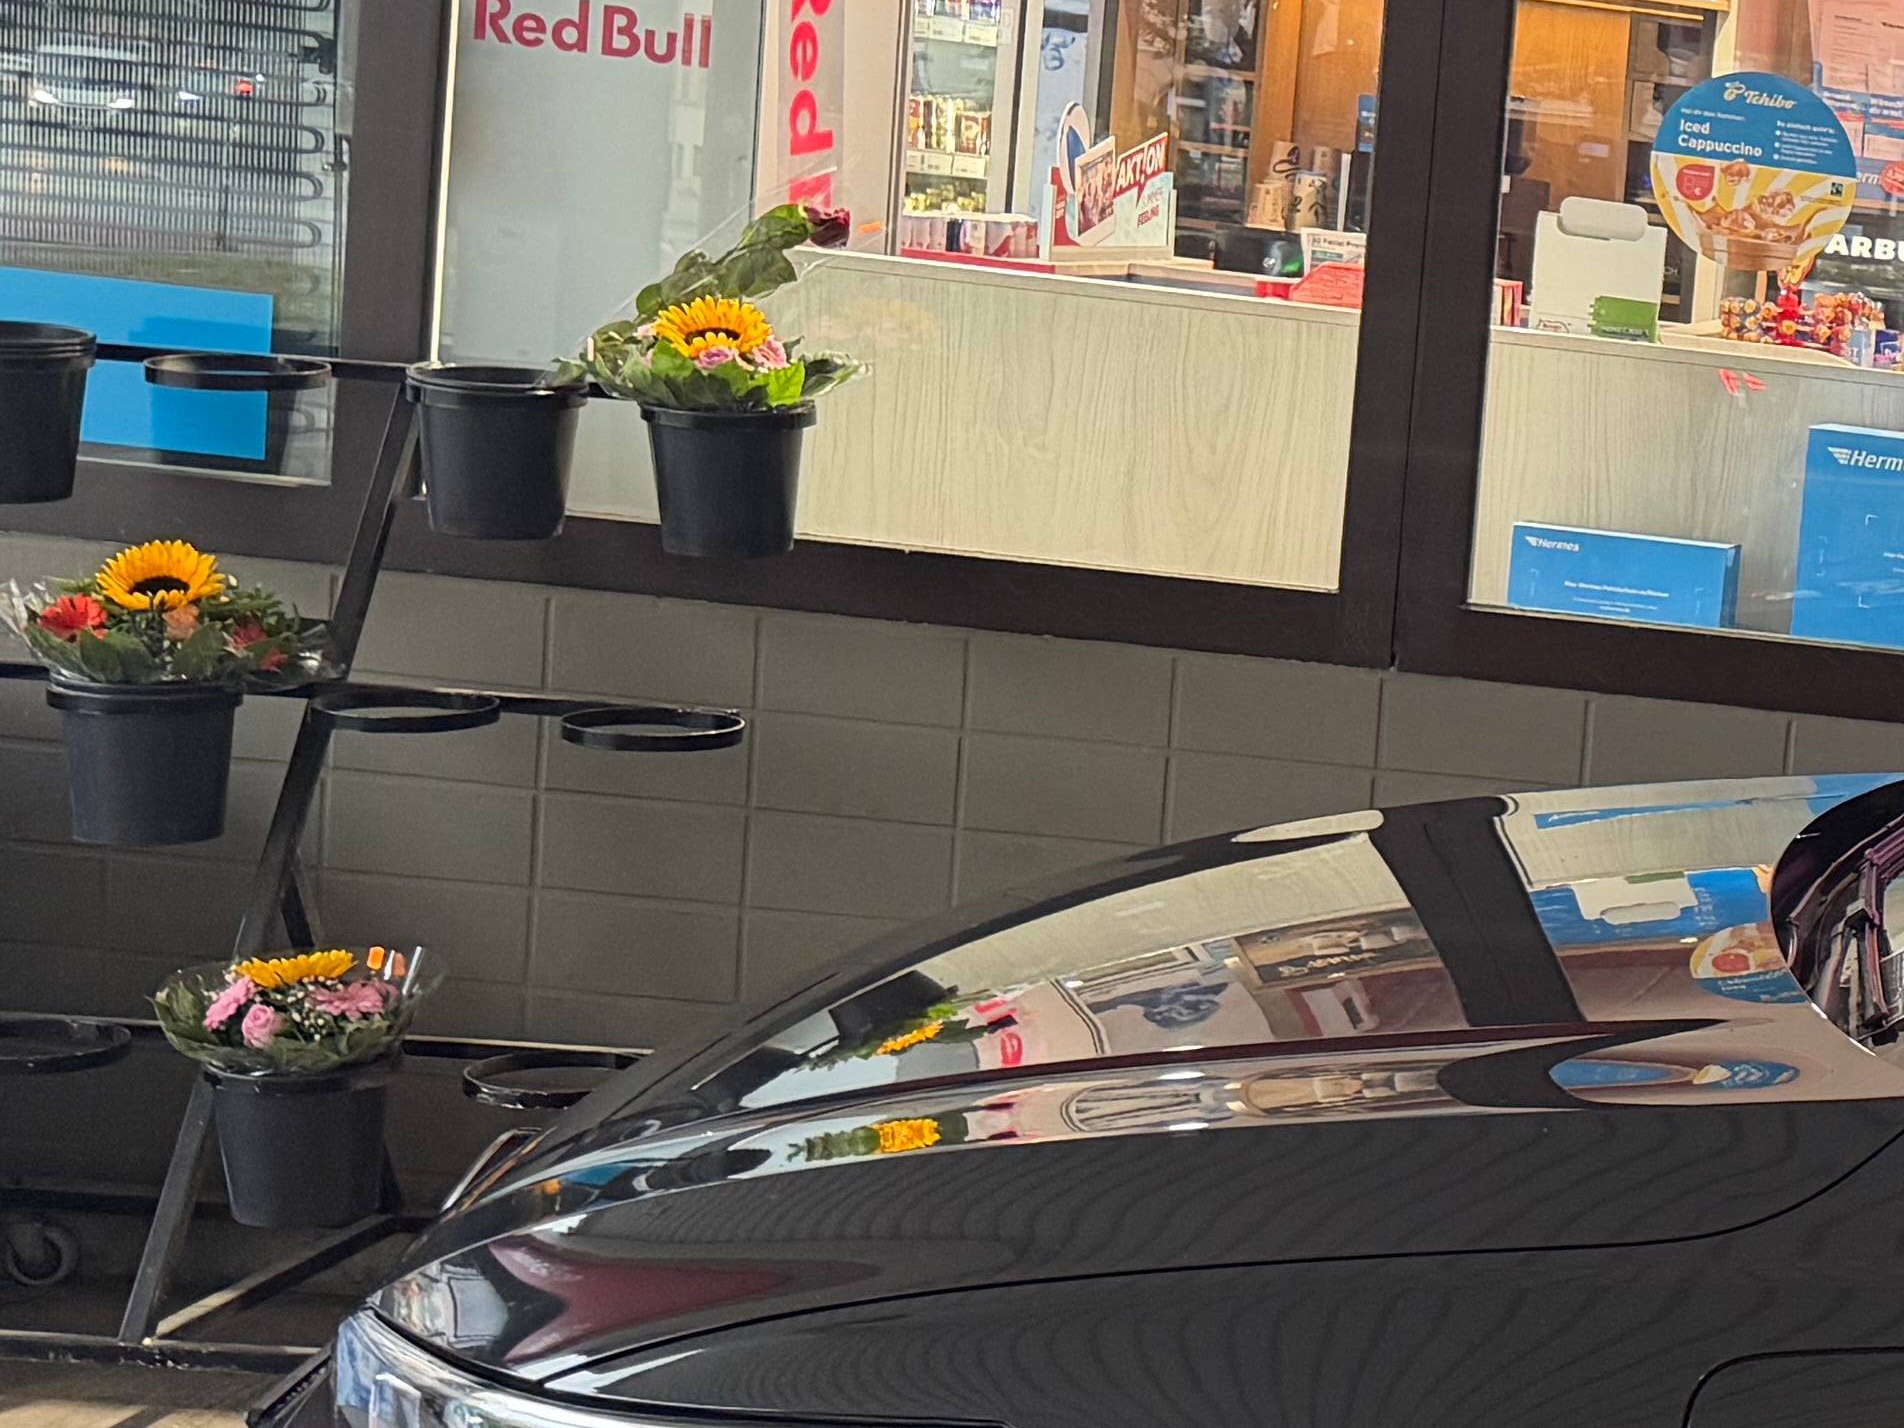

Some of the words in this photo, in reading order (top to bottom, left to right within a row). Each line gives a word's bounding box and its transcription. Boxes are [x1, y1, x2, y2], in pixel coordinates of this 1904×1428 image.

[601, 4, 712, 69] Bull
[1744, 90, 1798, 109] Tchibo
[1680, 119, 1710, 135] Iced
[1678, 135, 1763, 157] Cappuccino
[1537, 537, 1580, 552] Hermes
